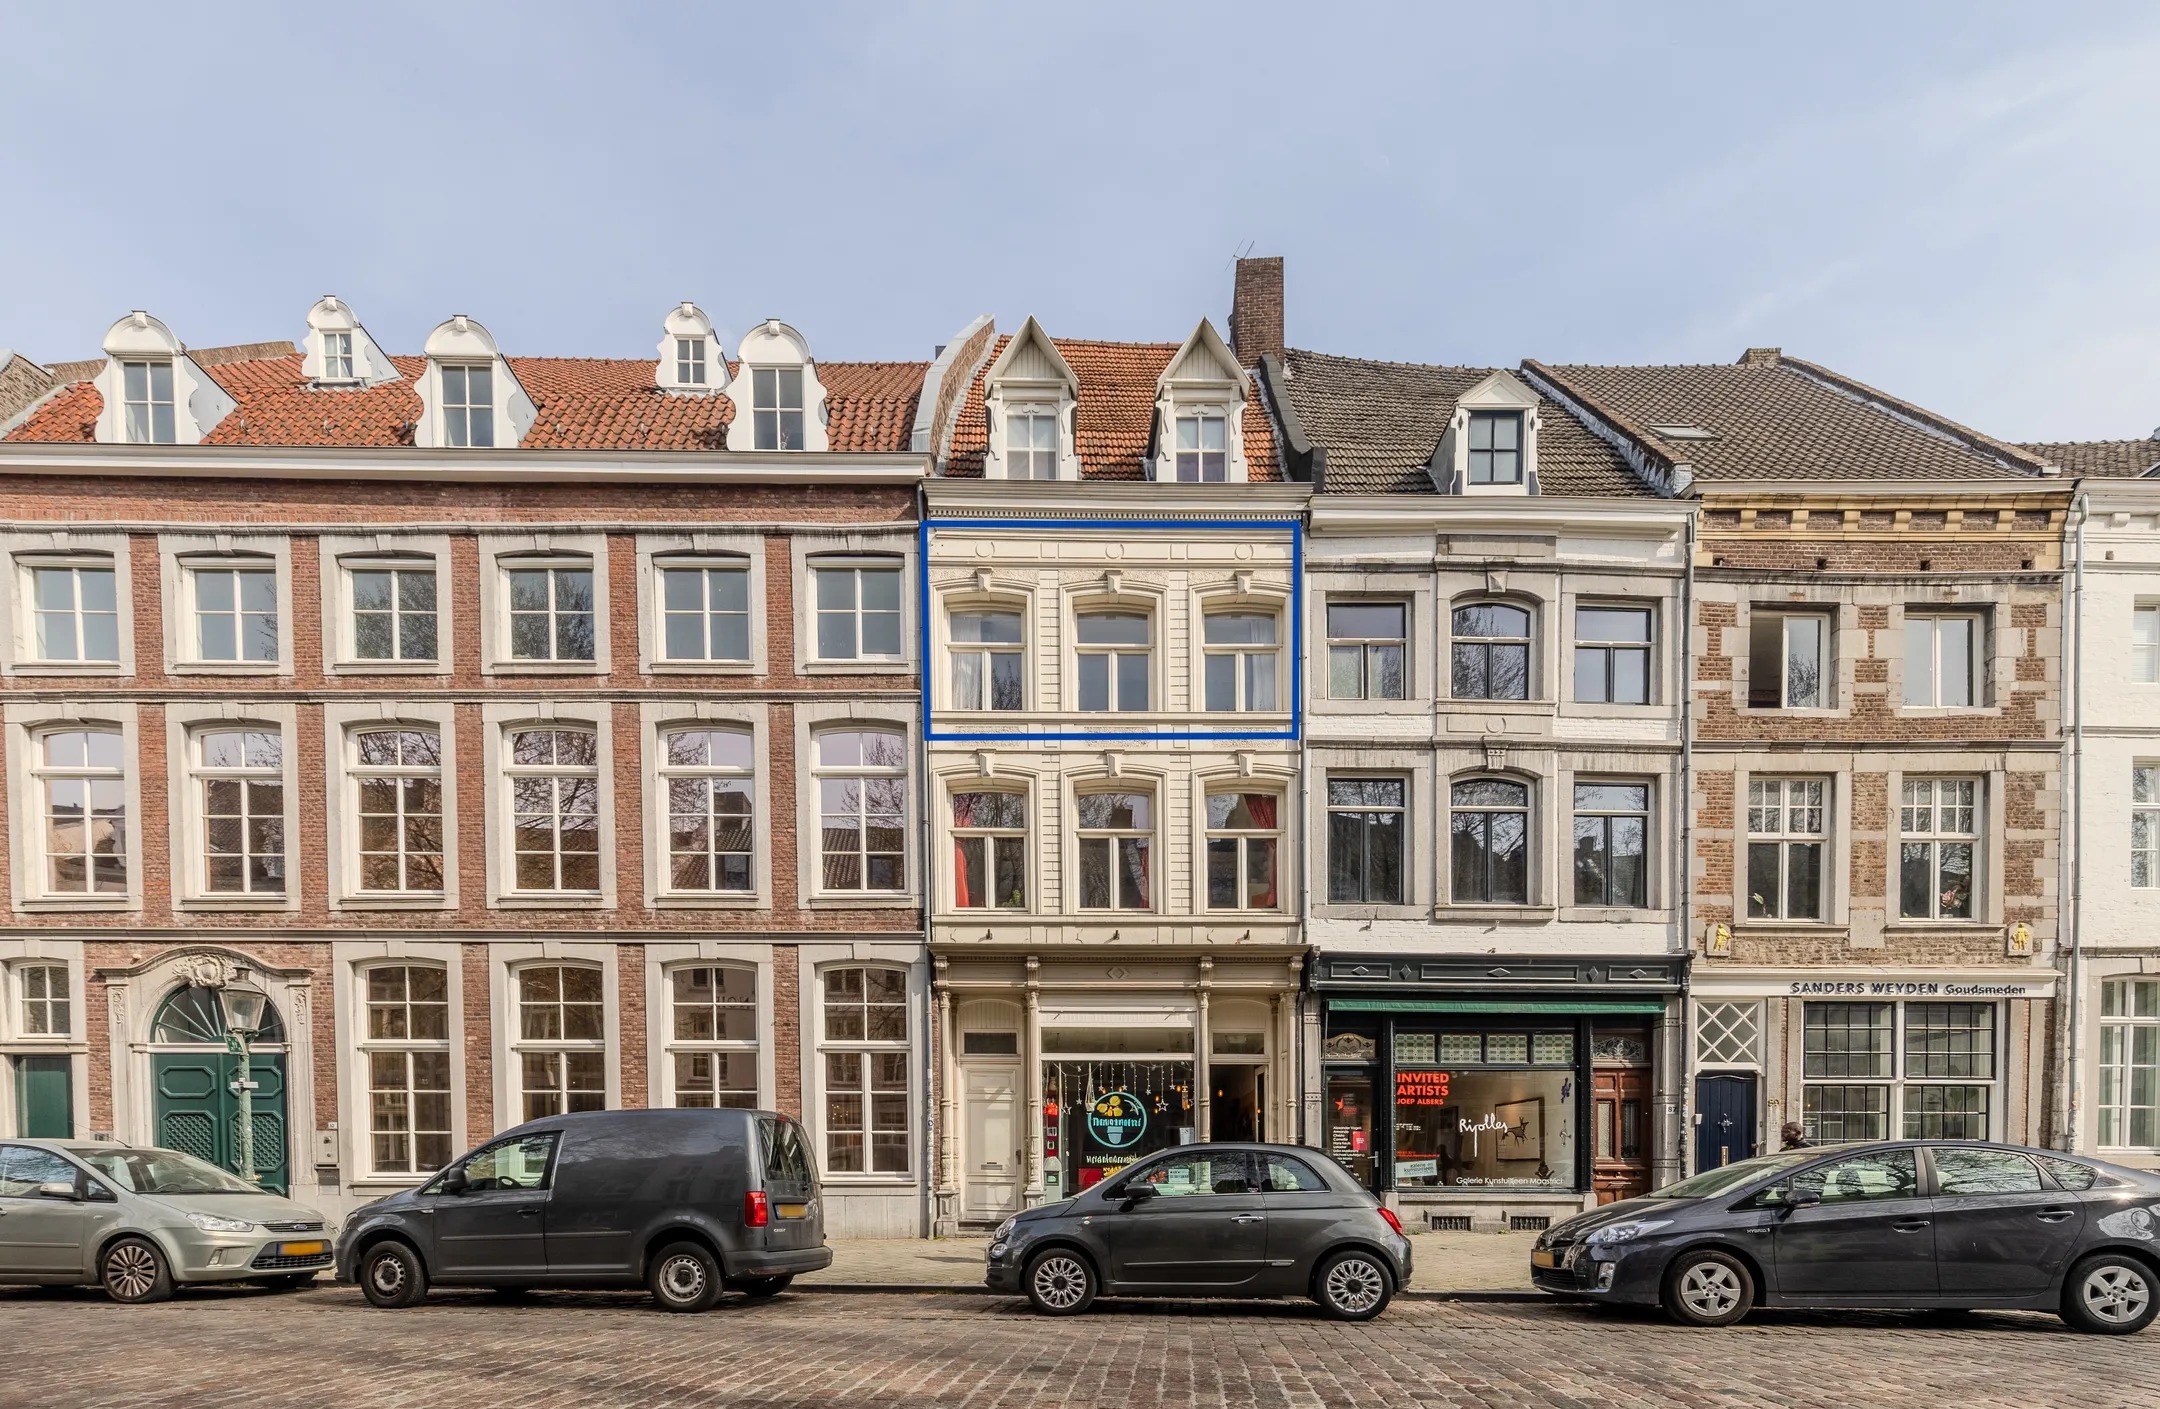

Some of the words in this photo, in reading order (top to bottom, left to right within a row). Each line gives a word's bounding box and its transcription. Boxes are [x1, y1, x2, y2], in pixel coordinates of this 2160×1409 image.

[1790, 982, 1865, 994] SANDERS
[1871, 983, 1938, 994] WEYDEN
[1945, 984, 2026, 995] Goudsmeden
[1397, 1073, 1450, 1083] INVITED
[1397, 1085, 1449, 1096] ARTISTS
